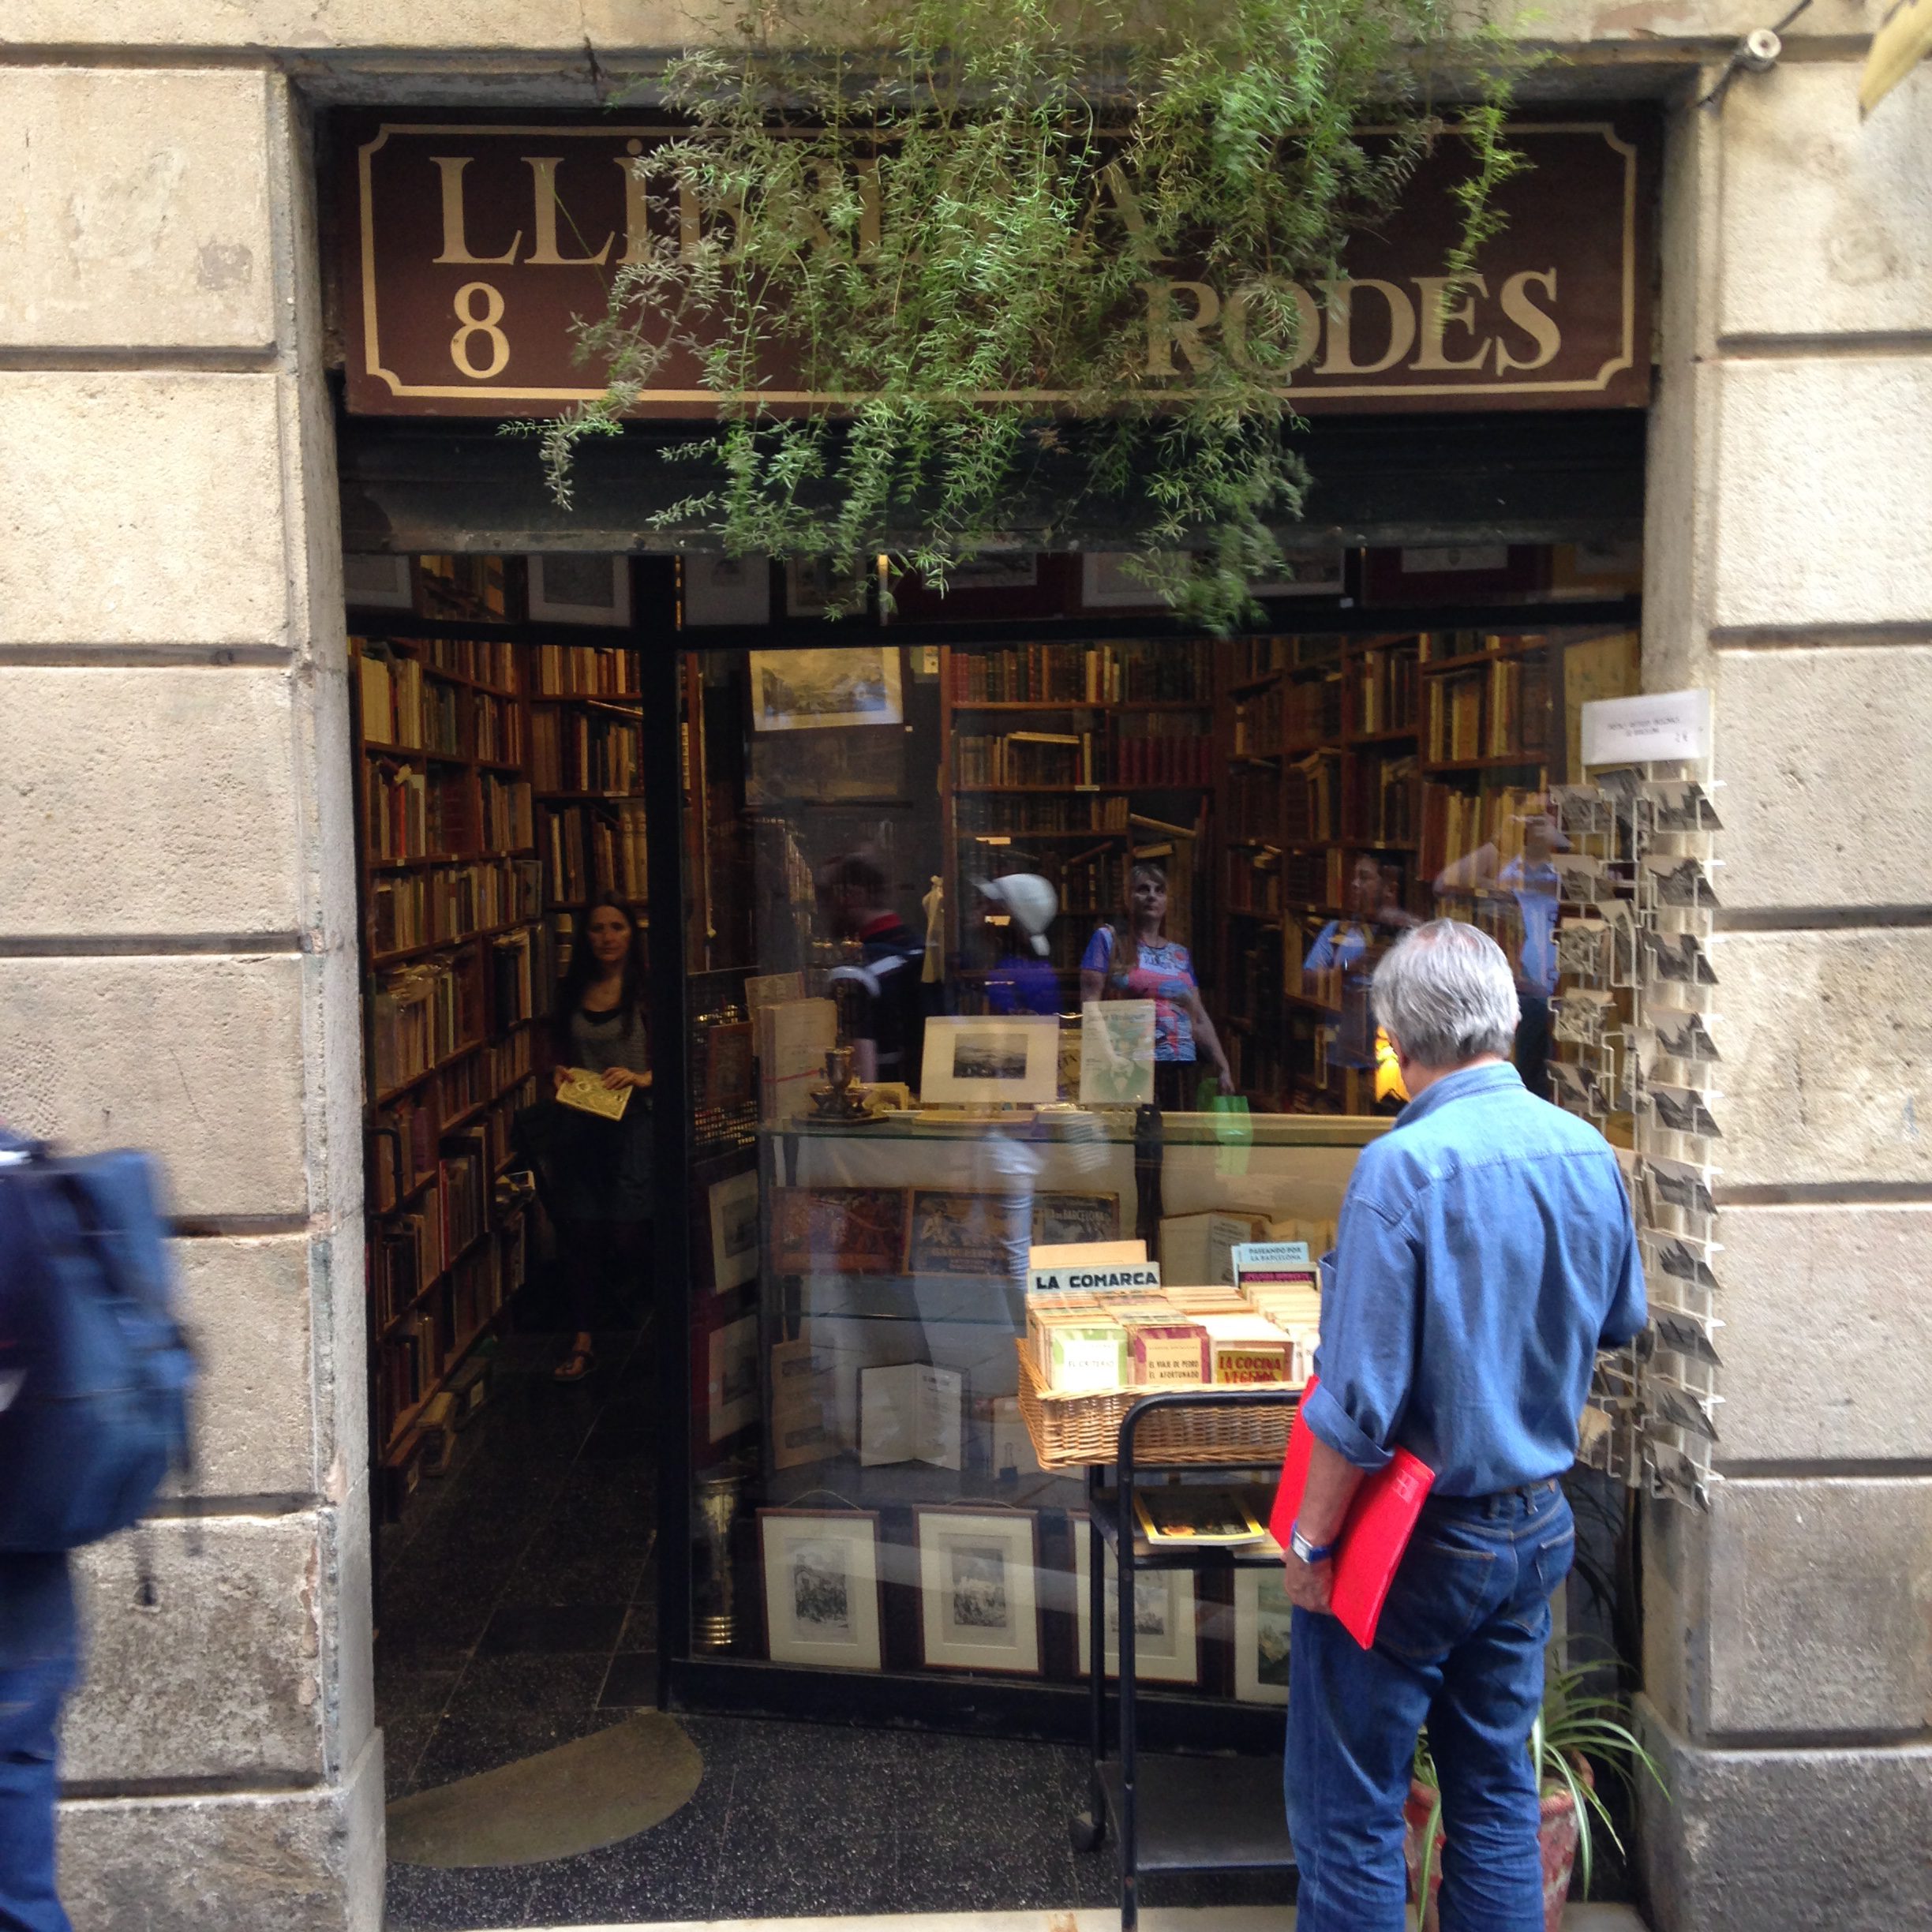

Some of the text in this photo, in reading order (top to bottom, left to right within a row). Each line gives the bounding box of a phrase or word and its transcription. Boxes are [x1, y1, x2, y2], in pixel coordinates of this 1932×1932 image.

[450, 281, 511, 379] 8
[1135, 266, 1563, 378] RODES
[1035, 1271, 1159, 1290] LA COMARCA
[1219, 1356, 1282, 1370] LA COCINA
